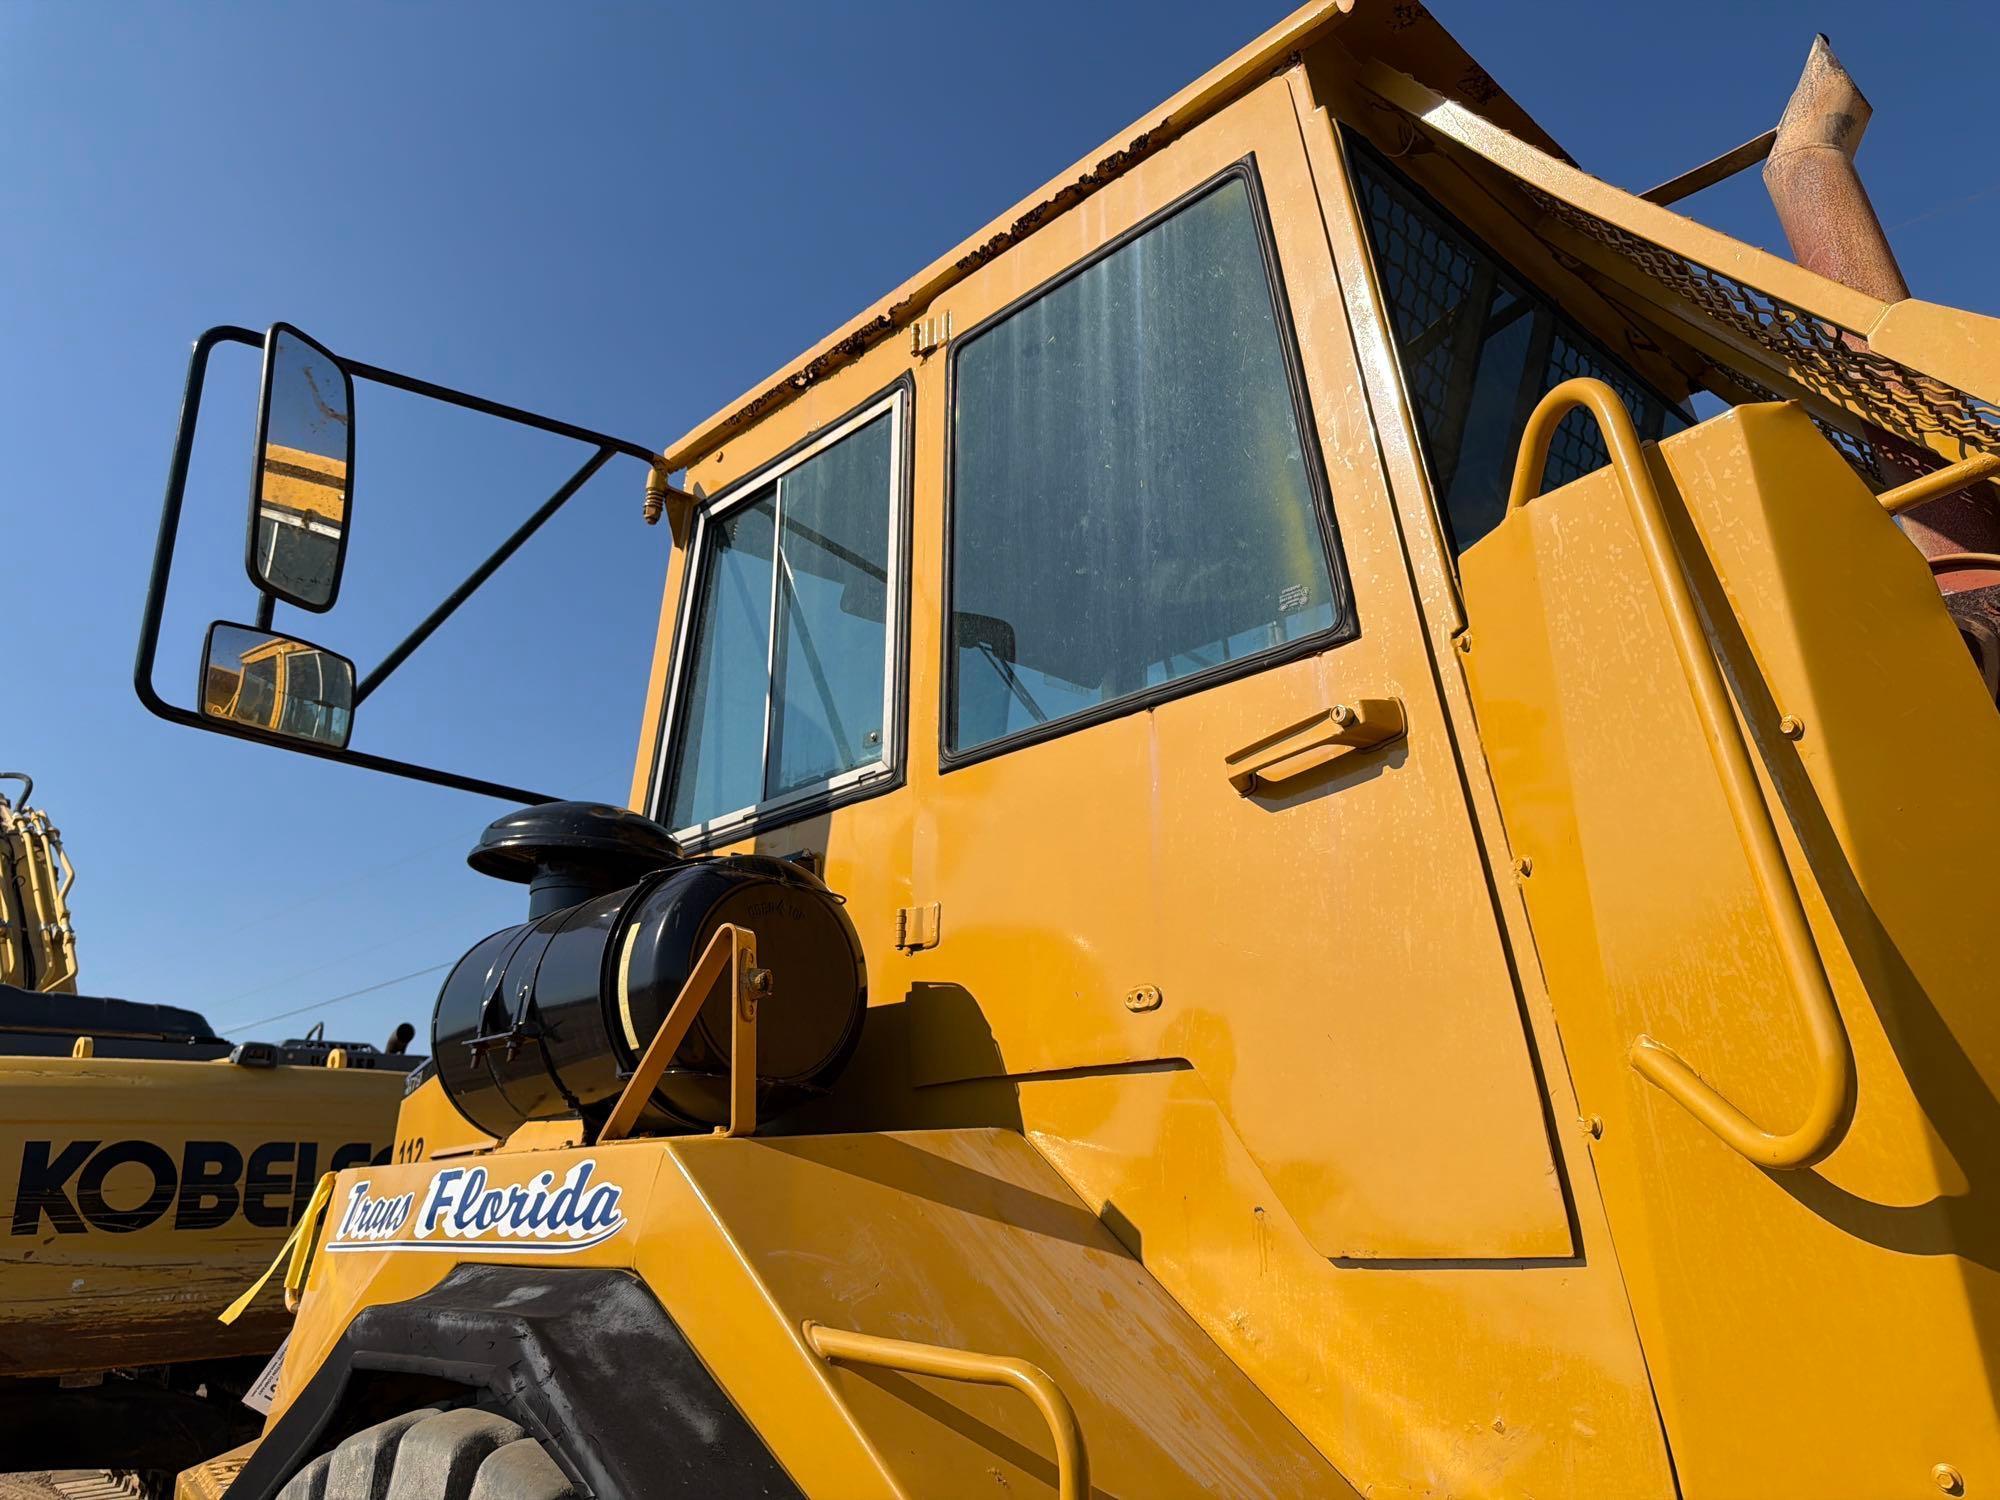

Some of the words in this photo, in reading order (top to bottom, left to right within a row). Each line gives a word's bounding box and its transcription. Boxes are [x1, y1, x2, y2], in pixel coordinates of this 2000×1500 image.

[11, 1140, 393, 1235] KOBEL
[399, 1136, 424, 1164] 112
[338, 1181, 415, 1239] Trans
[416, 1159, 622, 1239] Florida
